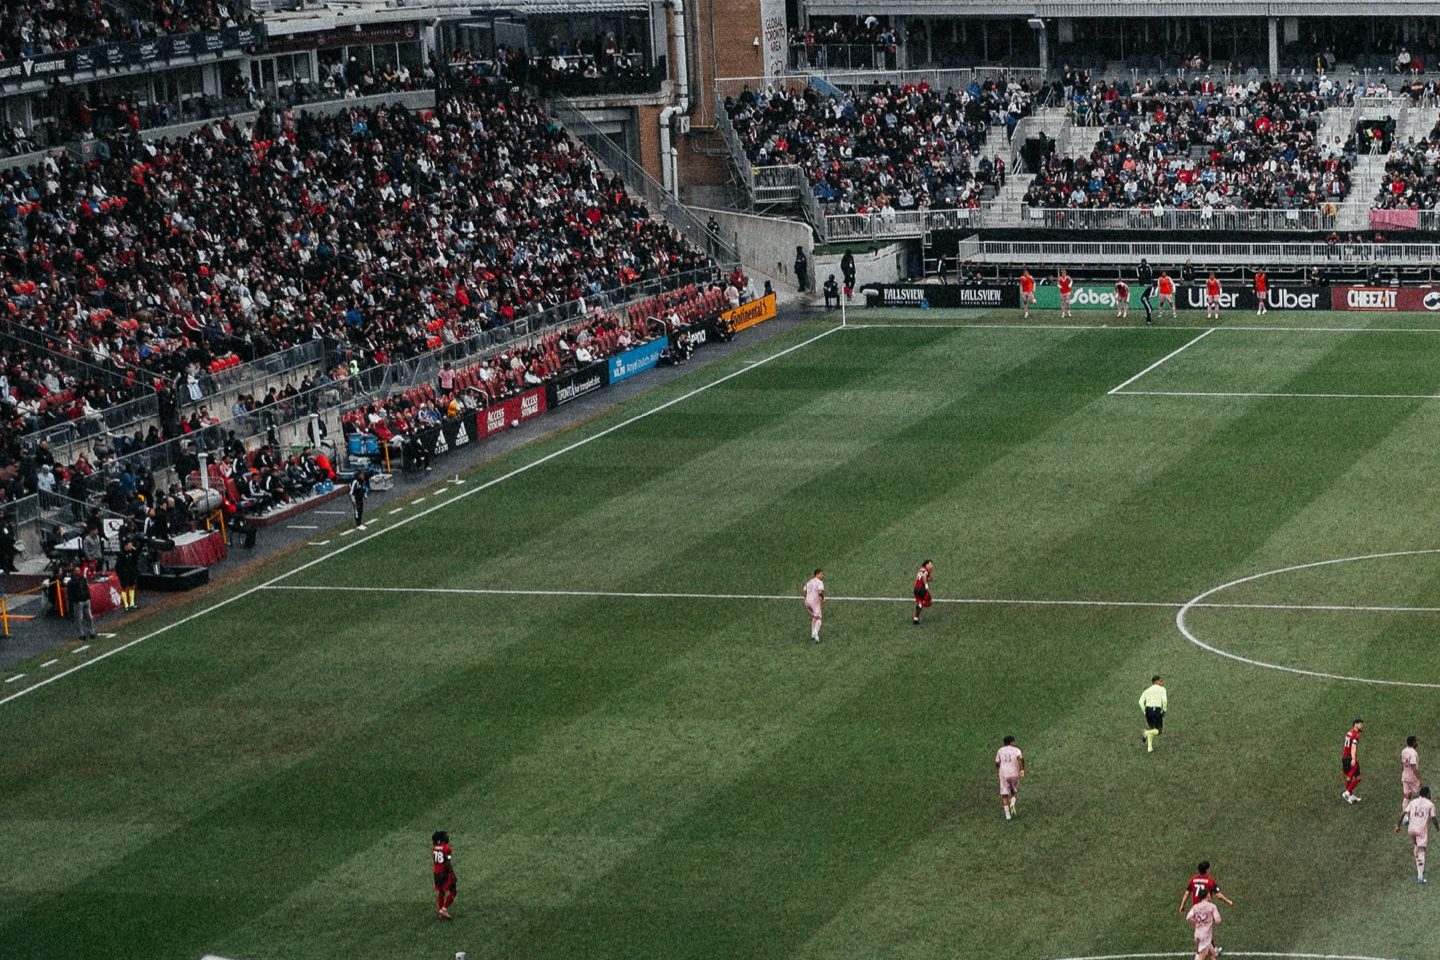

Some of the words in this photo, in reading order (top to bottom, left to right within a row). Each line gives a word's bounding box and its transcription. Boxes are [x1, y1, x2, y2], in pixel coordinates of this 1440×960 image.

[884, 288, 924, 300] FALLSVIEW
[961, 289, 1001, 300] FALLSVIEW
[1069, 287, 1118, 307] Sobey
[1268, 288, 1319, 308] Uber
[521, 394, 538, 409] ACCESS
[487, 408, 505, 421] ACCESS
